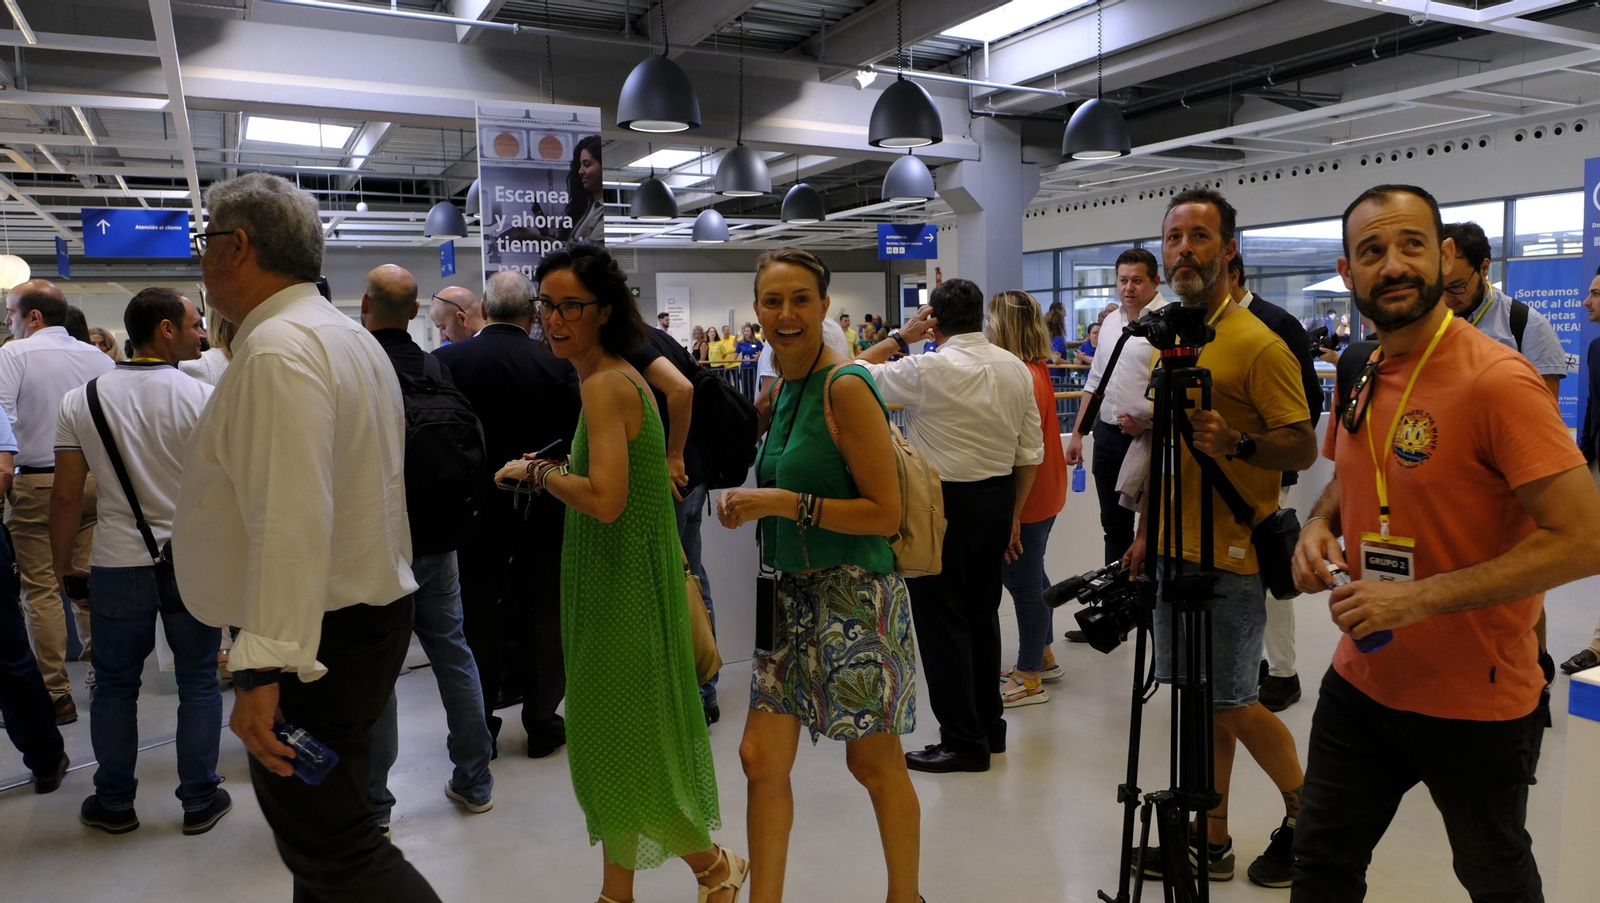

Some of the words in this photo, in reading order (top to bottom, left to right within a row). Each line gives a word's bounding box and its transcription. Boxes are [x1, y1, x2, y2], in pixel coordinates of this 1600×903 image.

[494, 185, 570, 204] Escanea
[494, 214, 506, 232] y
[511, 210, 573, 229] ahorra
[496, 236, 562, 257] tiempo
[1514, 288, 1579, 299] ¡Sorteamos
[1550, 299, 1561, 308] al
[1564, 298, 1582, 308] día
[1544, 312, 1576, 321] rjetas
[1368, 556, 1399, 568] GRUPO
